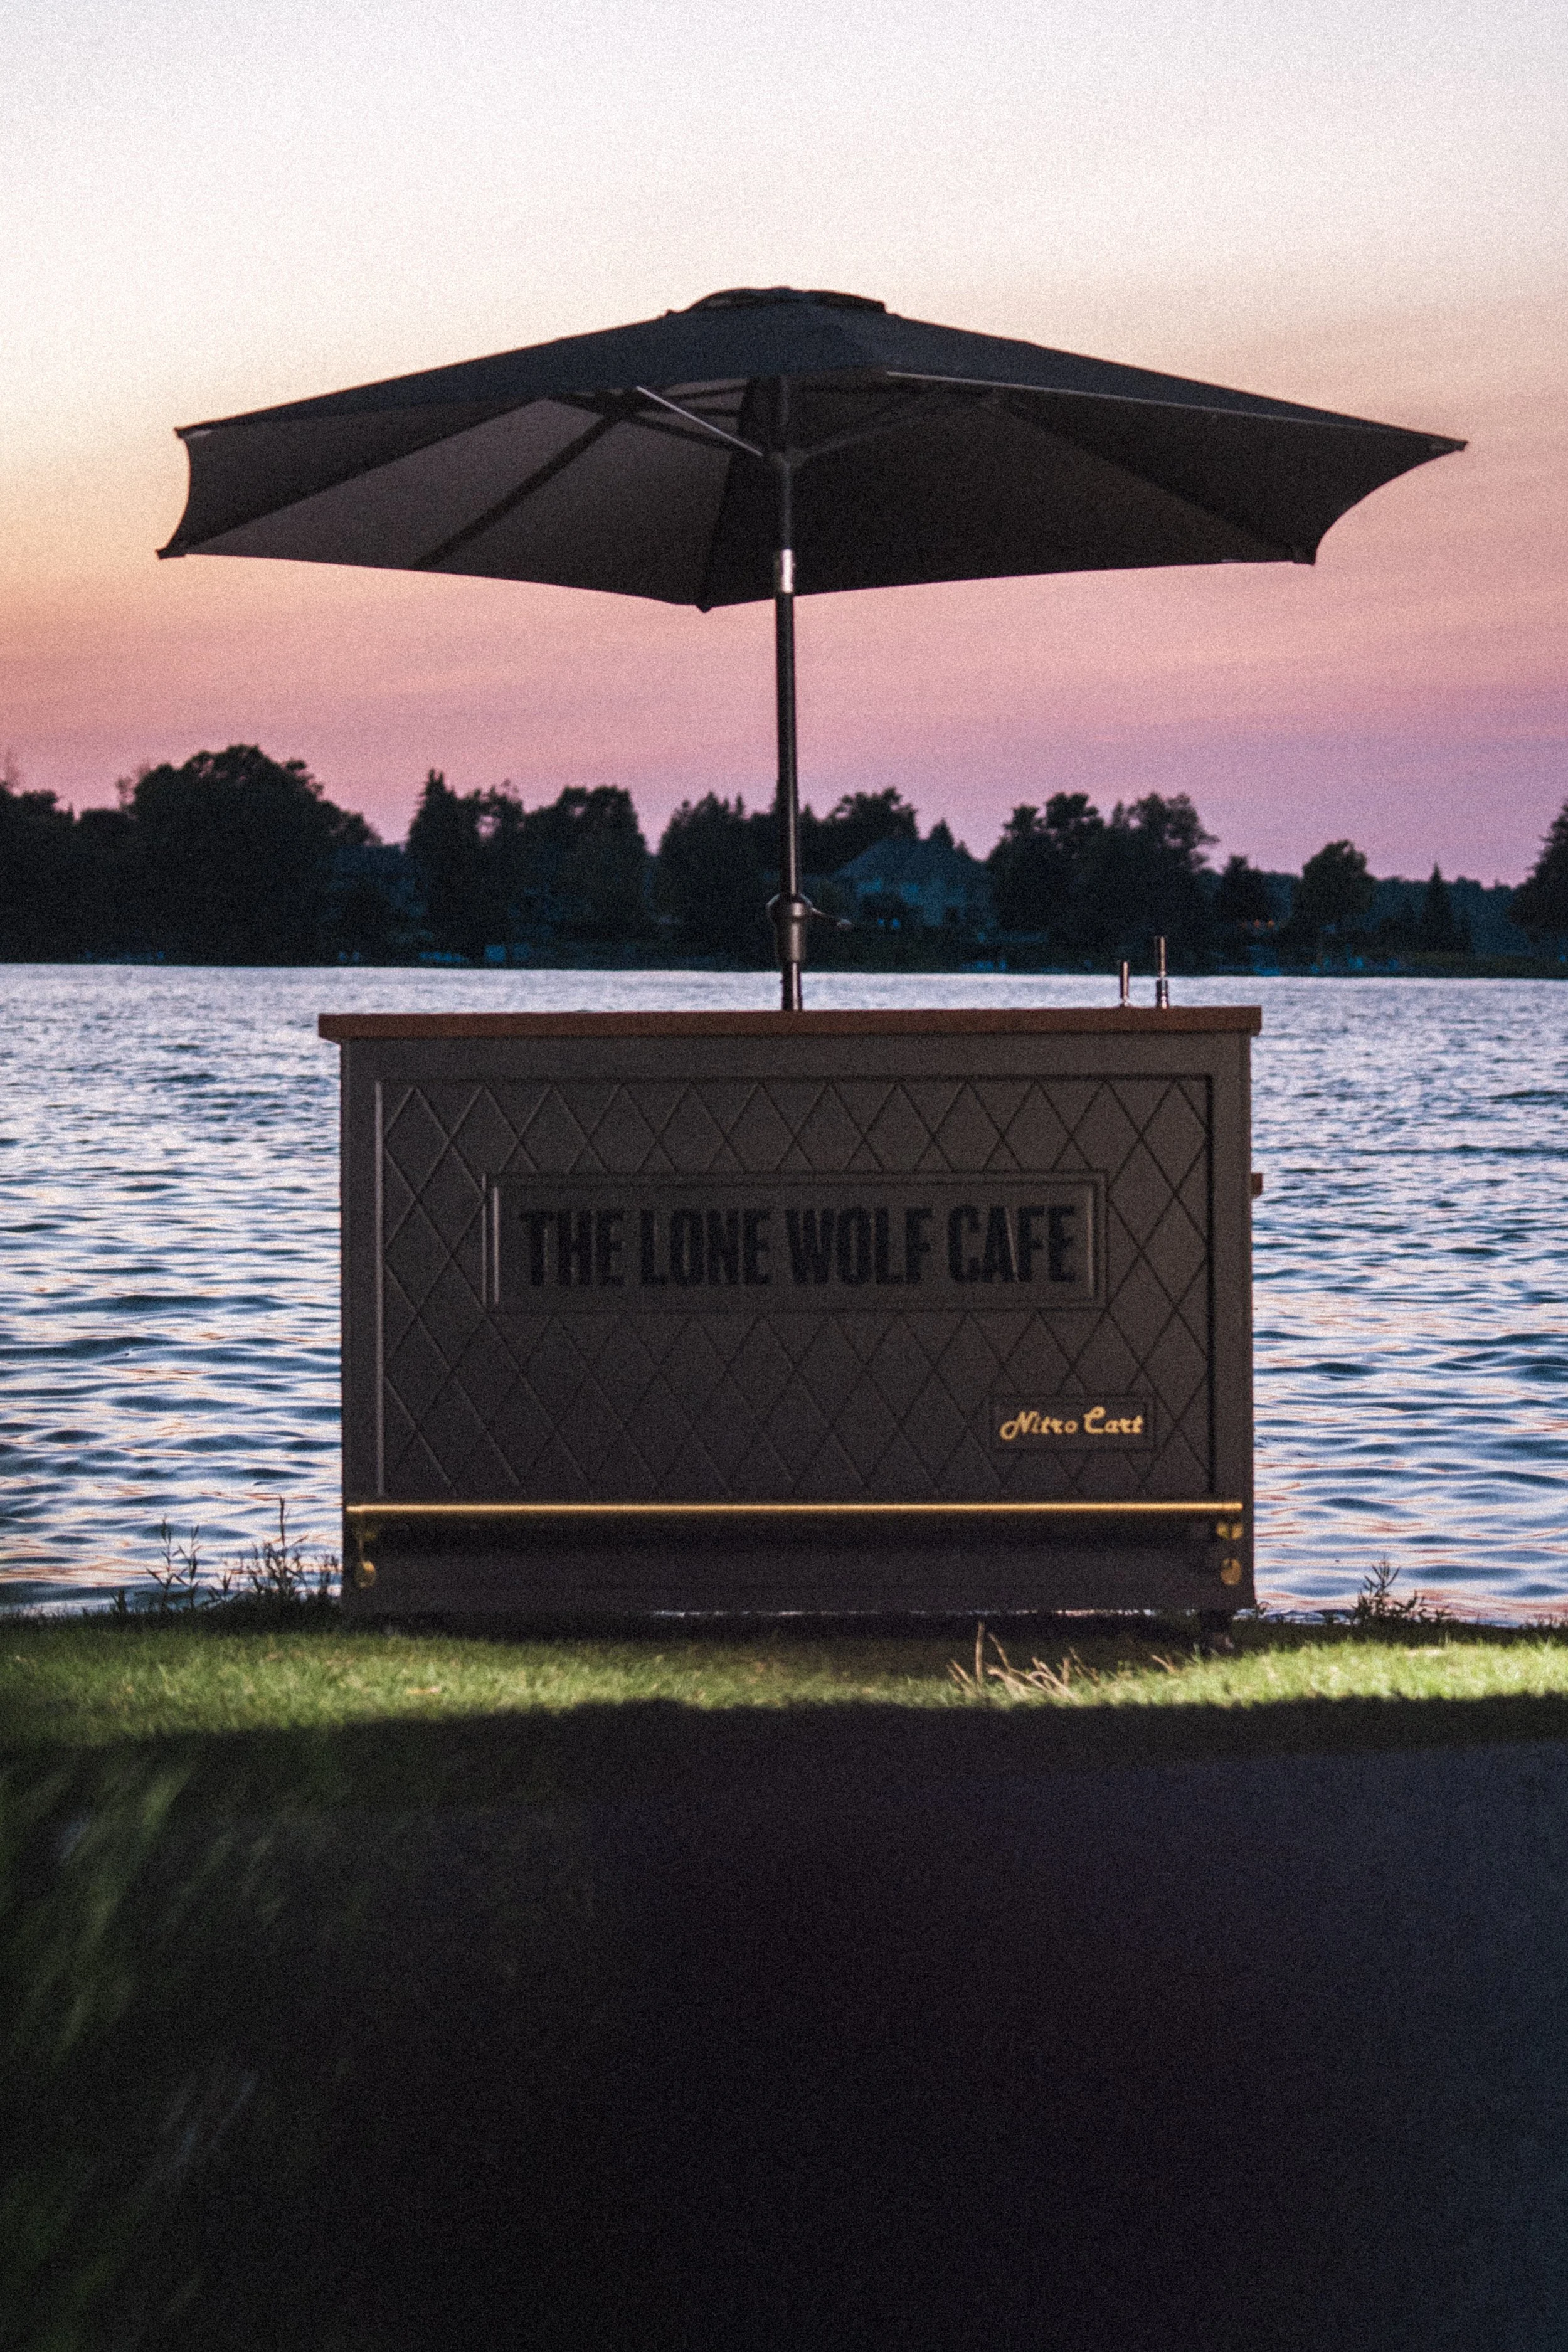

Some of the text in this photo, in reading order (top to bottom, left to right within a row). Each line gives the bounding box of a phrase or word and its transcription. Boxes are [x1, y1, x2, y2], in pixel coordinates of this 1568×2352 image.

[519, 1205, 1076, 1286] THE LONE WOLF CAFE
[1000, 1406, 1143, 1440] Nitro Cart
